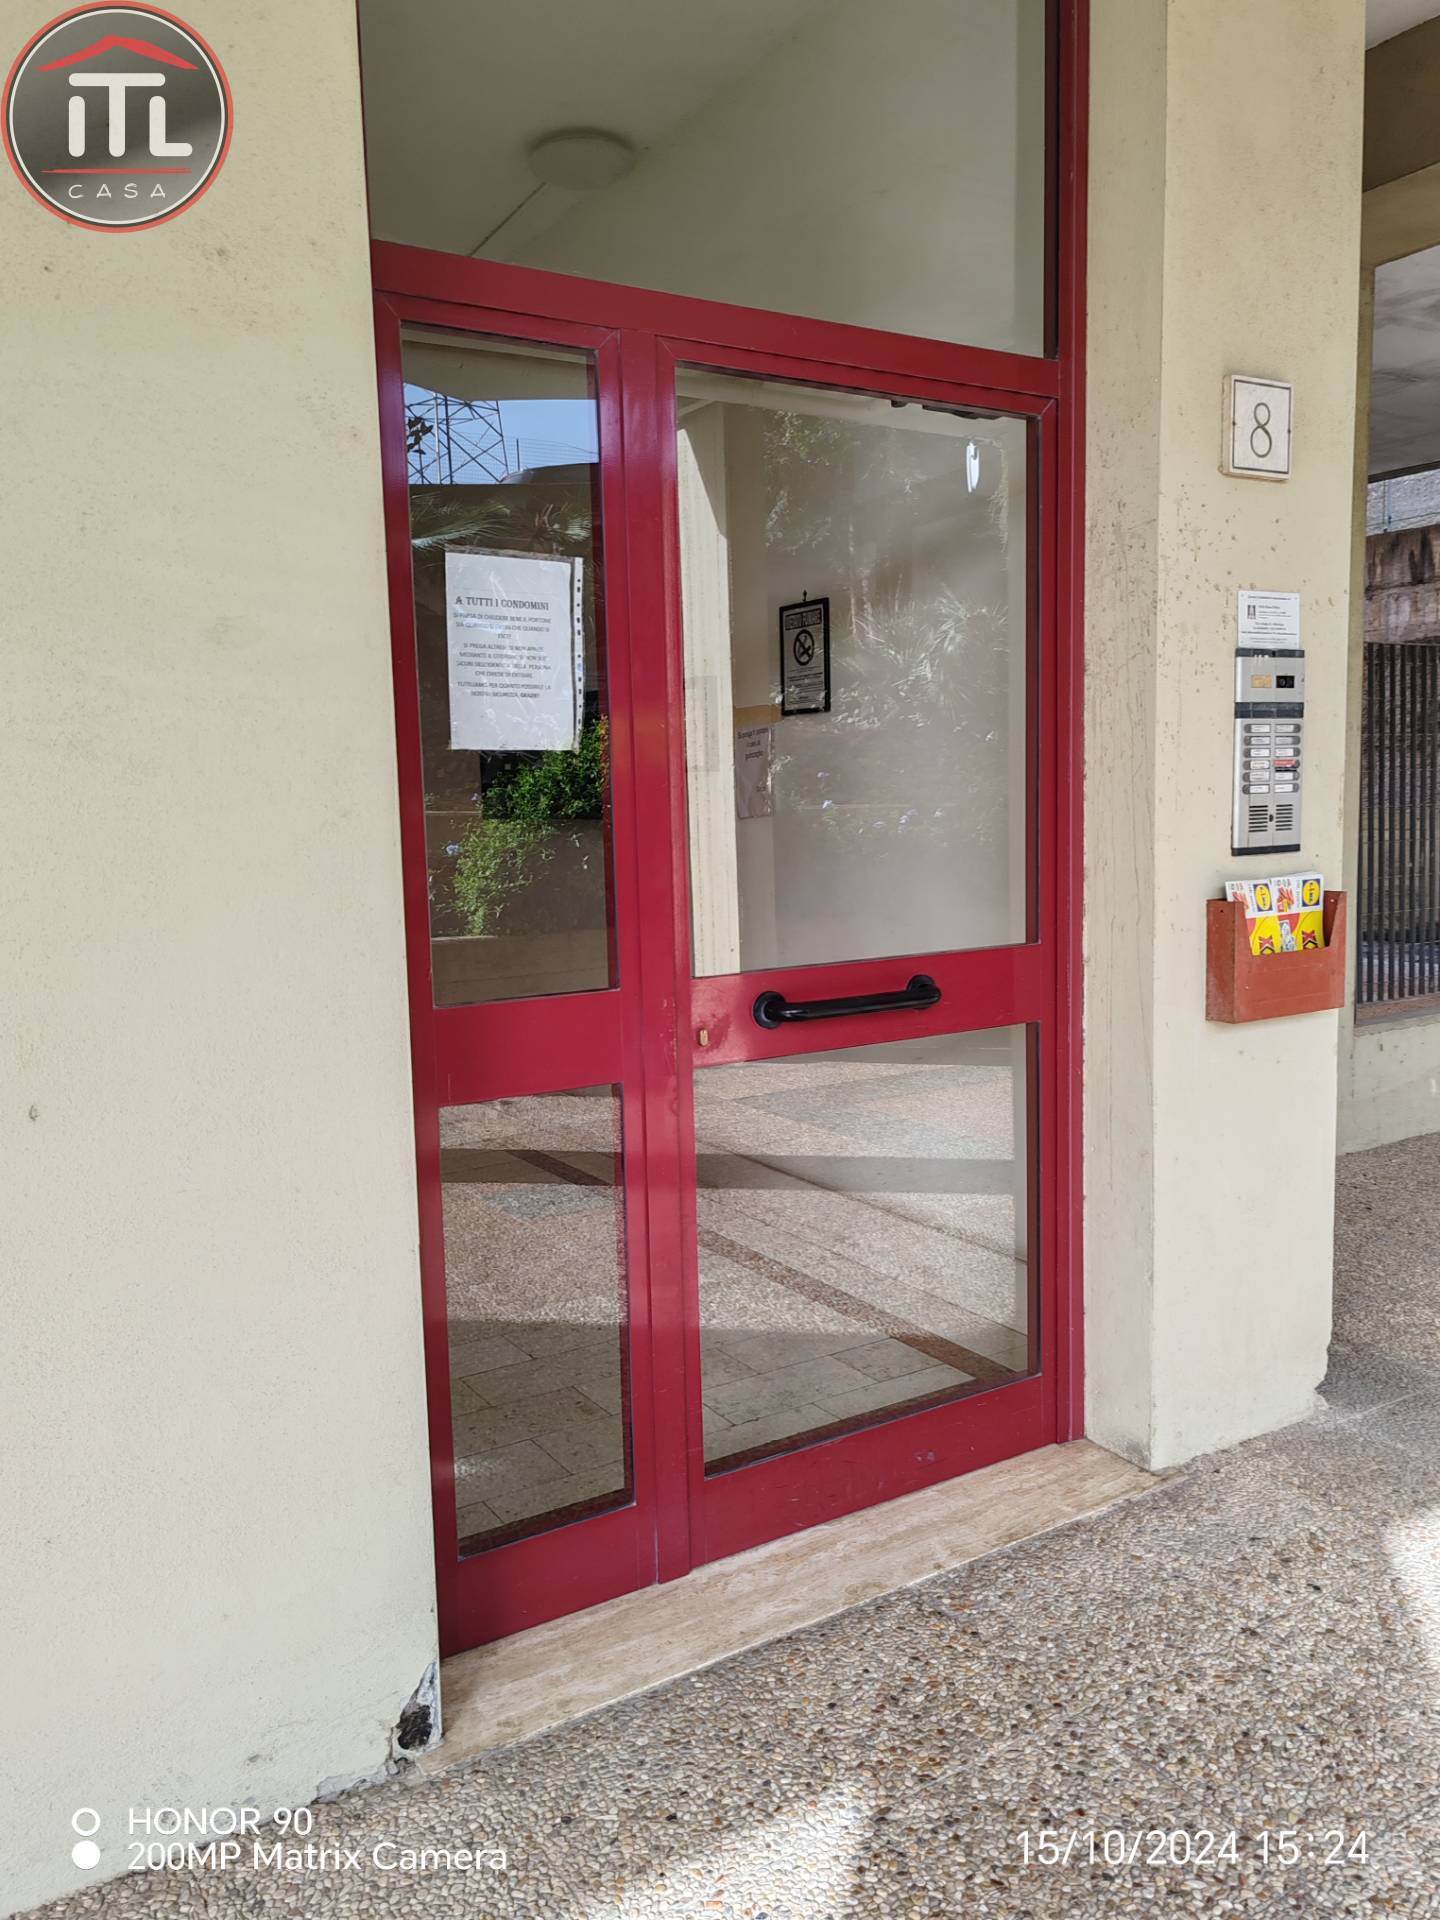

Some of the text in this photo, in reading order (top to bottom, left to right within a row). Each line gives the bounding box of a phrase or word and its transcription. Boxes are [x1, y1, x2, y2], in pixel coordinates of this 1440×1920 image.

[1250, 402, 1272, 458] 8
[455, 596, 549, 611] A TUTTI I CONDOMINI
